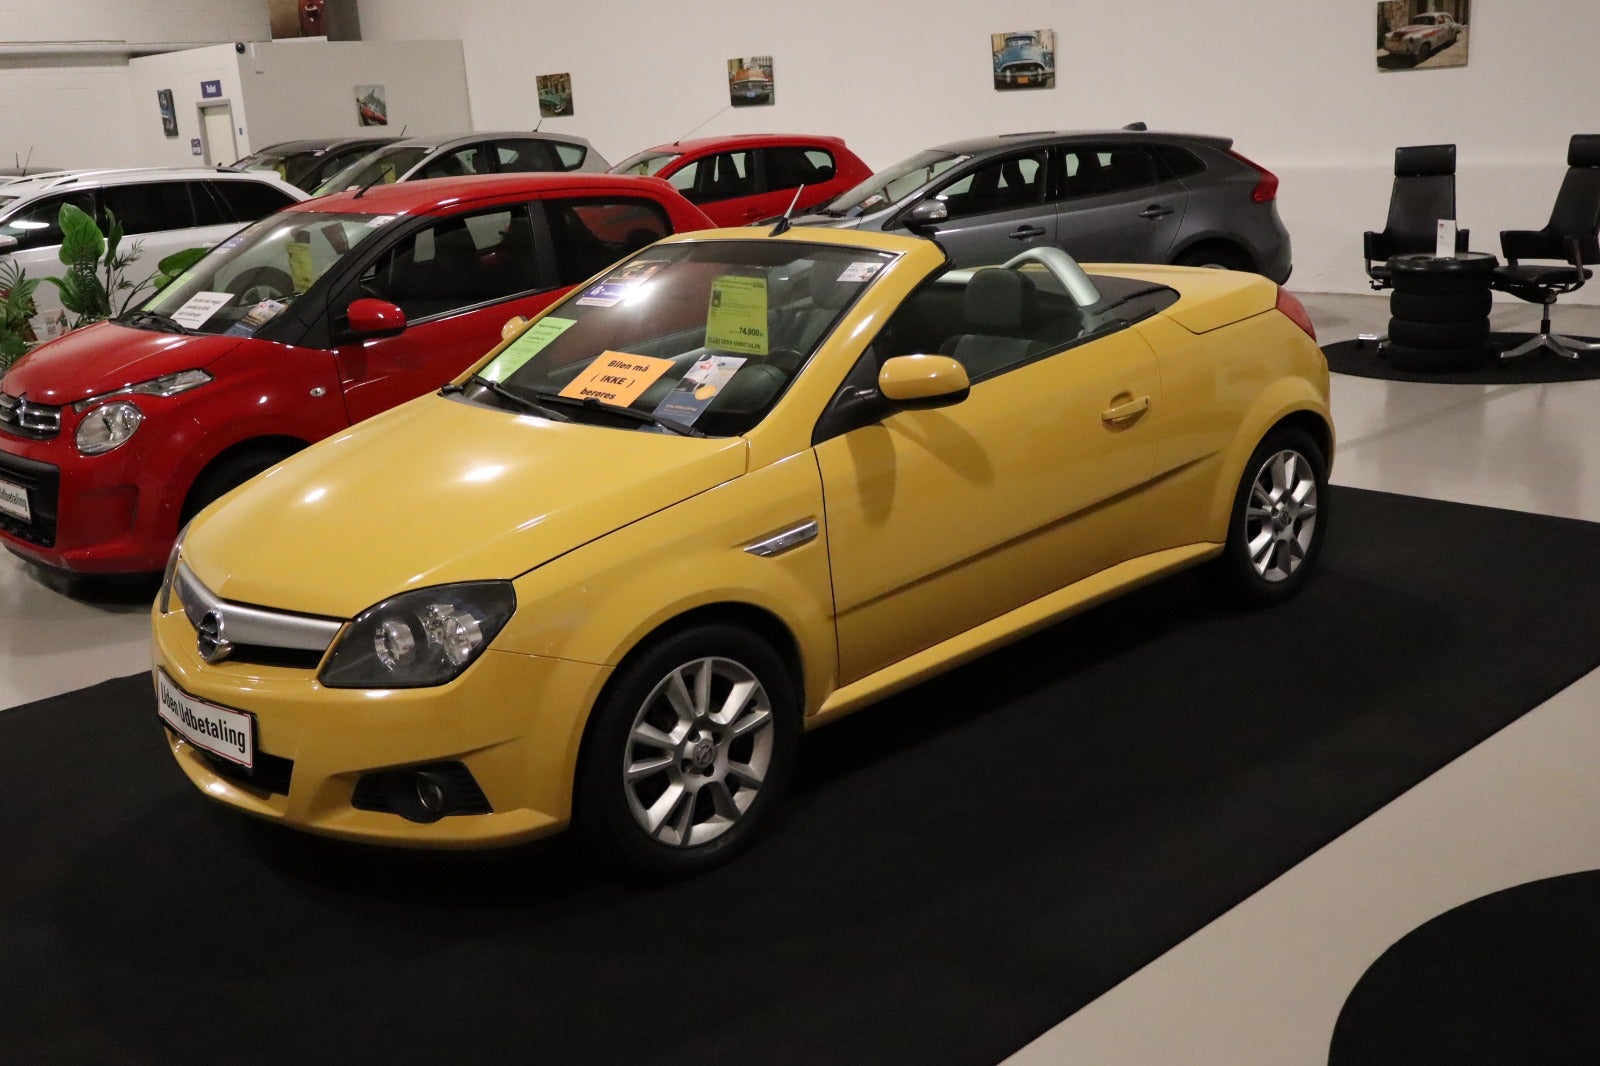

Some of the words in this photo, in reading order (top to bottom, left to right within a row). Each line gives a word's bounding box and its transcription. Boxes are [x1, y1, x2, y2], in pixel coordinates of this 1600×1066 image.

[607, 360, 632, 369] Bilen
[632, 364, 651, 373] må
[600, 374, 628, 385] IKKE
[160, 681, 180, 718] Uden
[177, 700, 246, 754] Udbetaling
